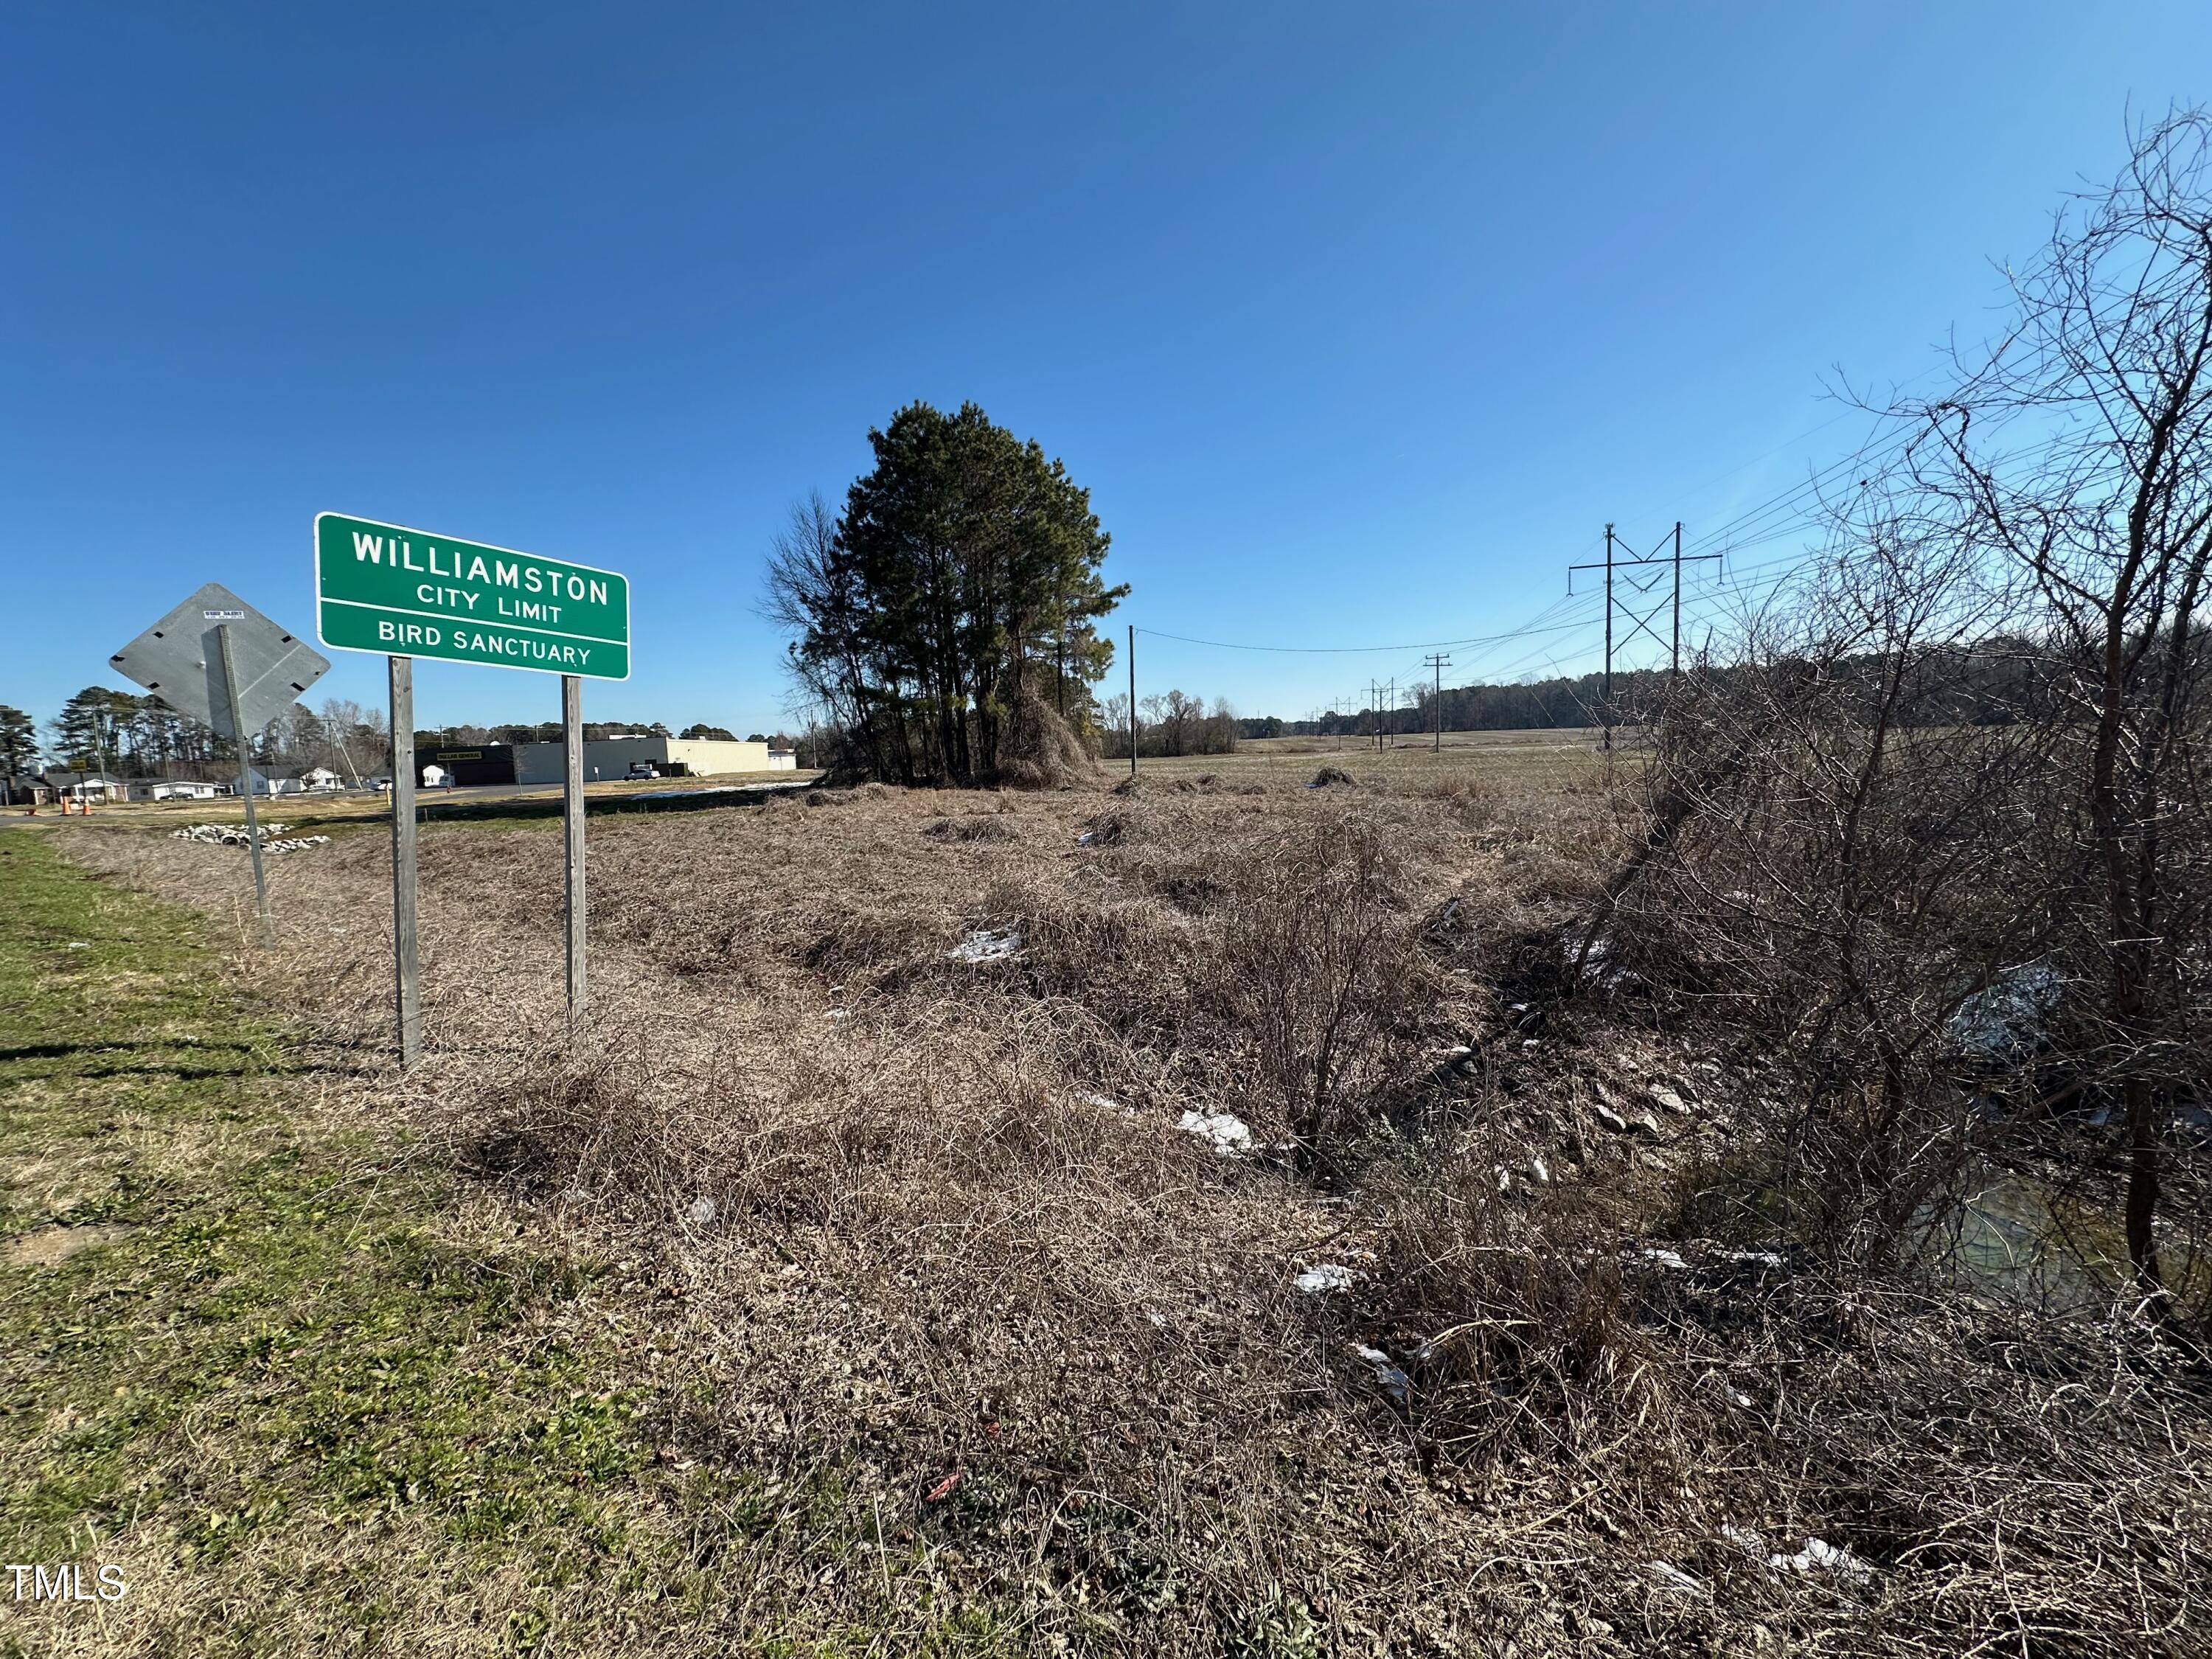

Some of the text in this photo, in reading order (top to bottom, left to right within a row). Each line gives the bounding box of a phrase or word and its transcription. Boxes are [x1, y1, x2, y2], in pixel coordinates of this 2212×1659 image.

[352, 531, 608, 605] WILLIAMSTON
[416, 584, 562, 623] CITY LIMIT
[378, 621, 591, 665] BIRD SANCTUARY
